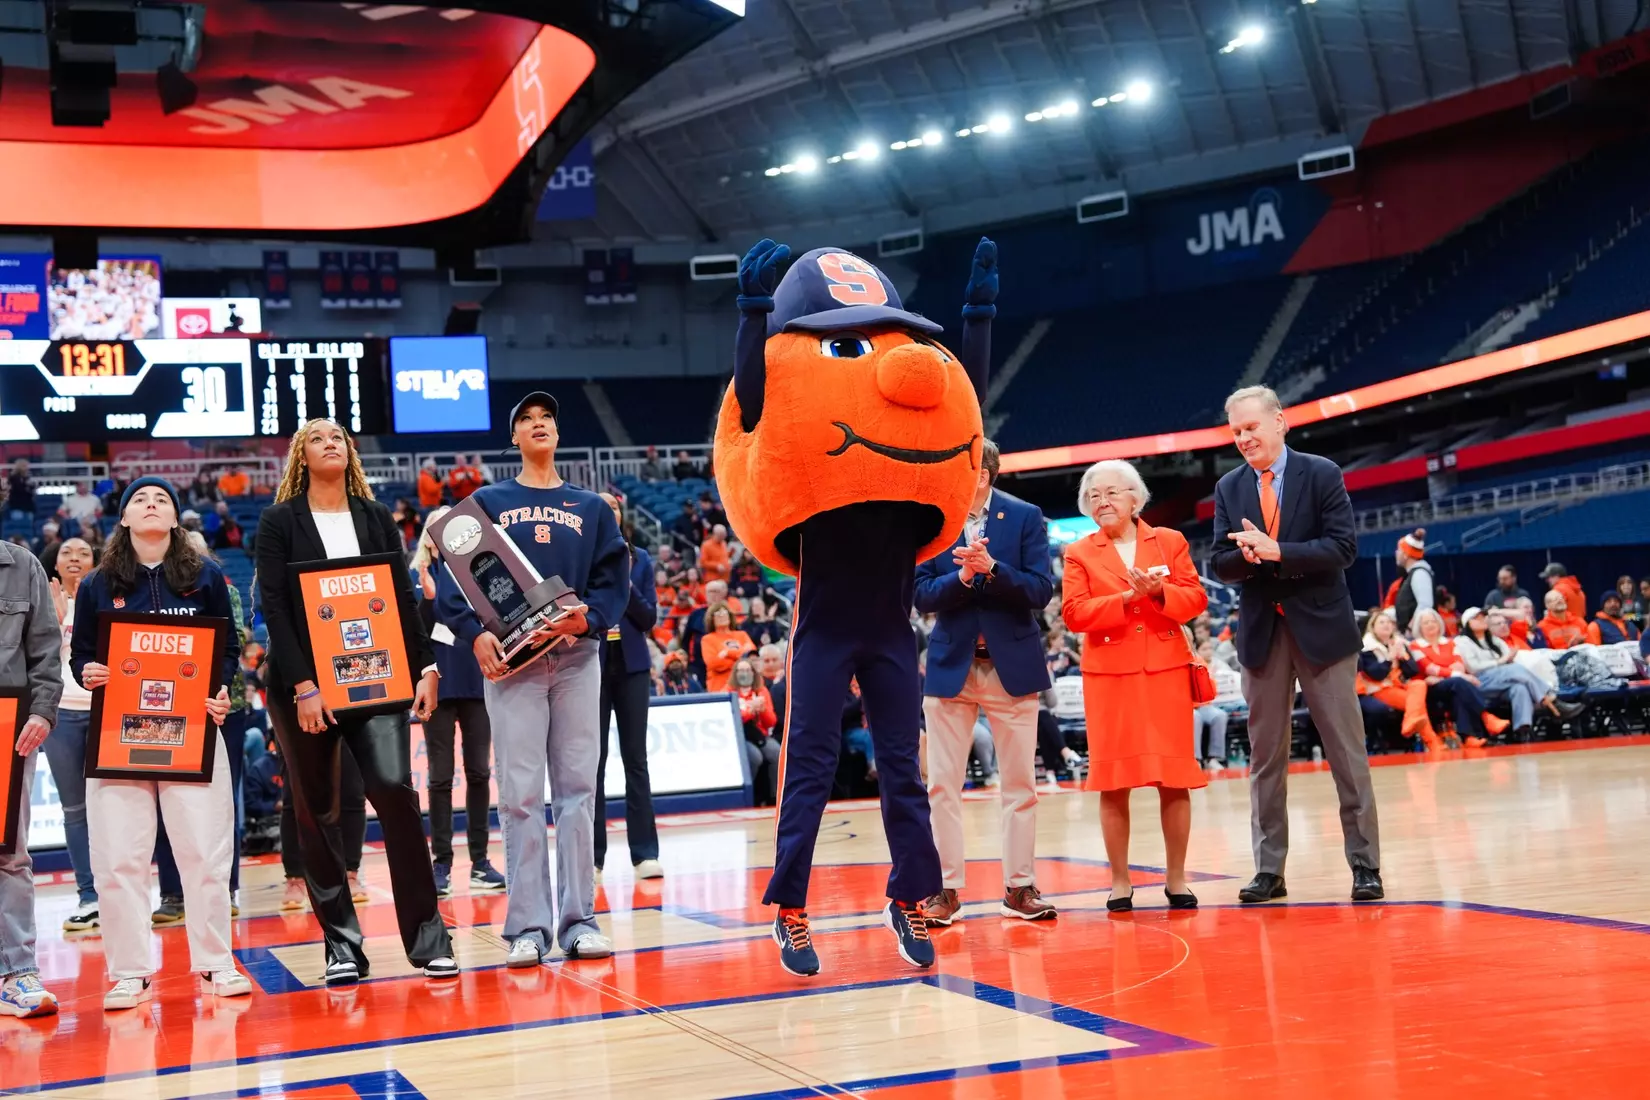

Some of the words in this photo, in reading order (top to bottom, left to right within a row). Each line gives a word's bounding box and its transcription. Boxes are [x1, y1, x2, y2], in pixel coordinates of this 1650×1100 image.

[178, 76, 413, 136] JMA
[1186, 202, 1285, 255] JMA
[816, 252, 888, 306] S
[60, 344, 125, 376] 13:31
[181, 367, 227, 413] 30
[499, 506, 583, 536] SYRACUSE
[534, 524, 550, 543] S
[322, 575, 371, 595] 'CUSE
[134, 633, 187, 653] 'CUSE
[501, 628, 523, 649] ATIONAL
